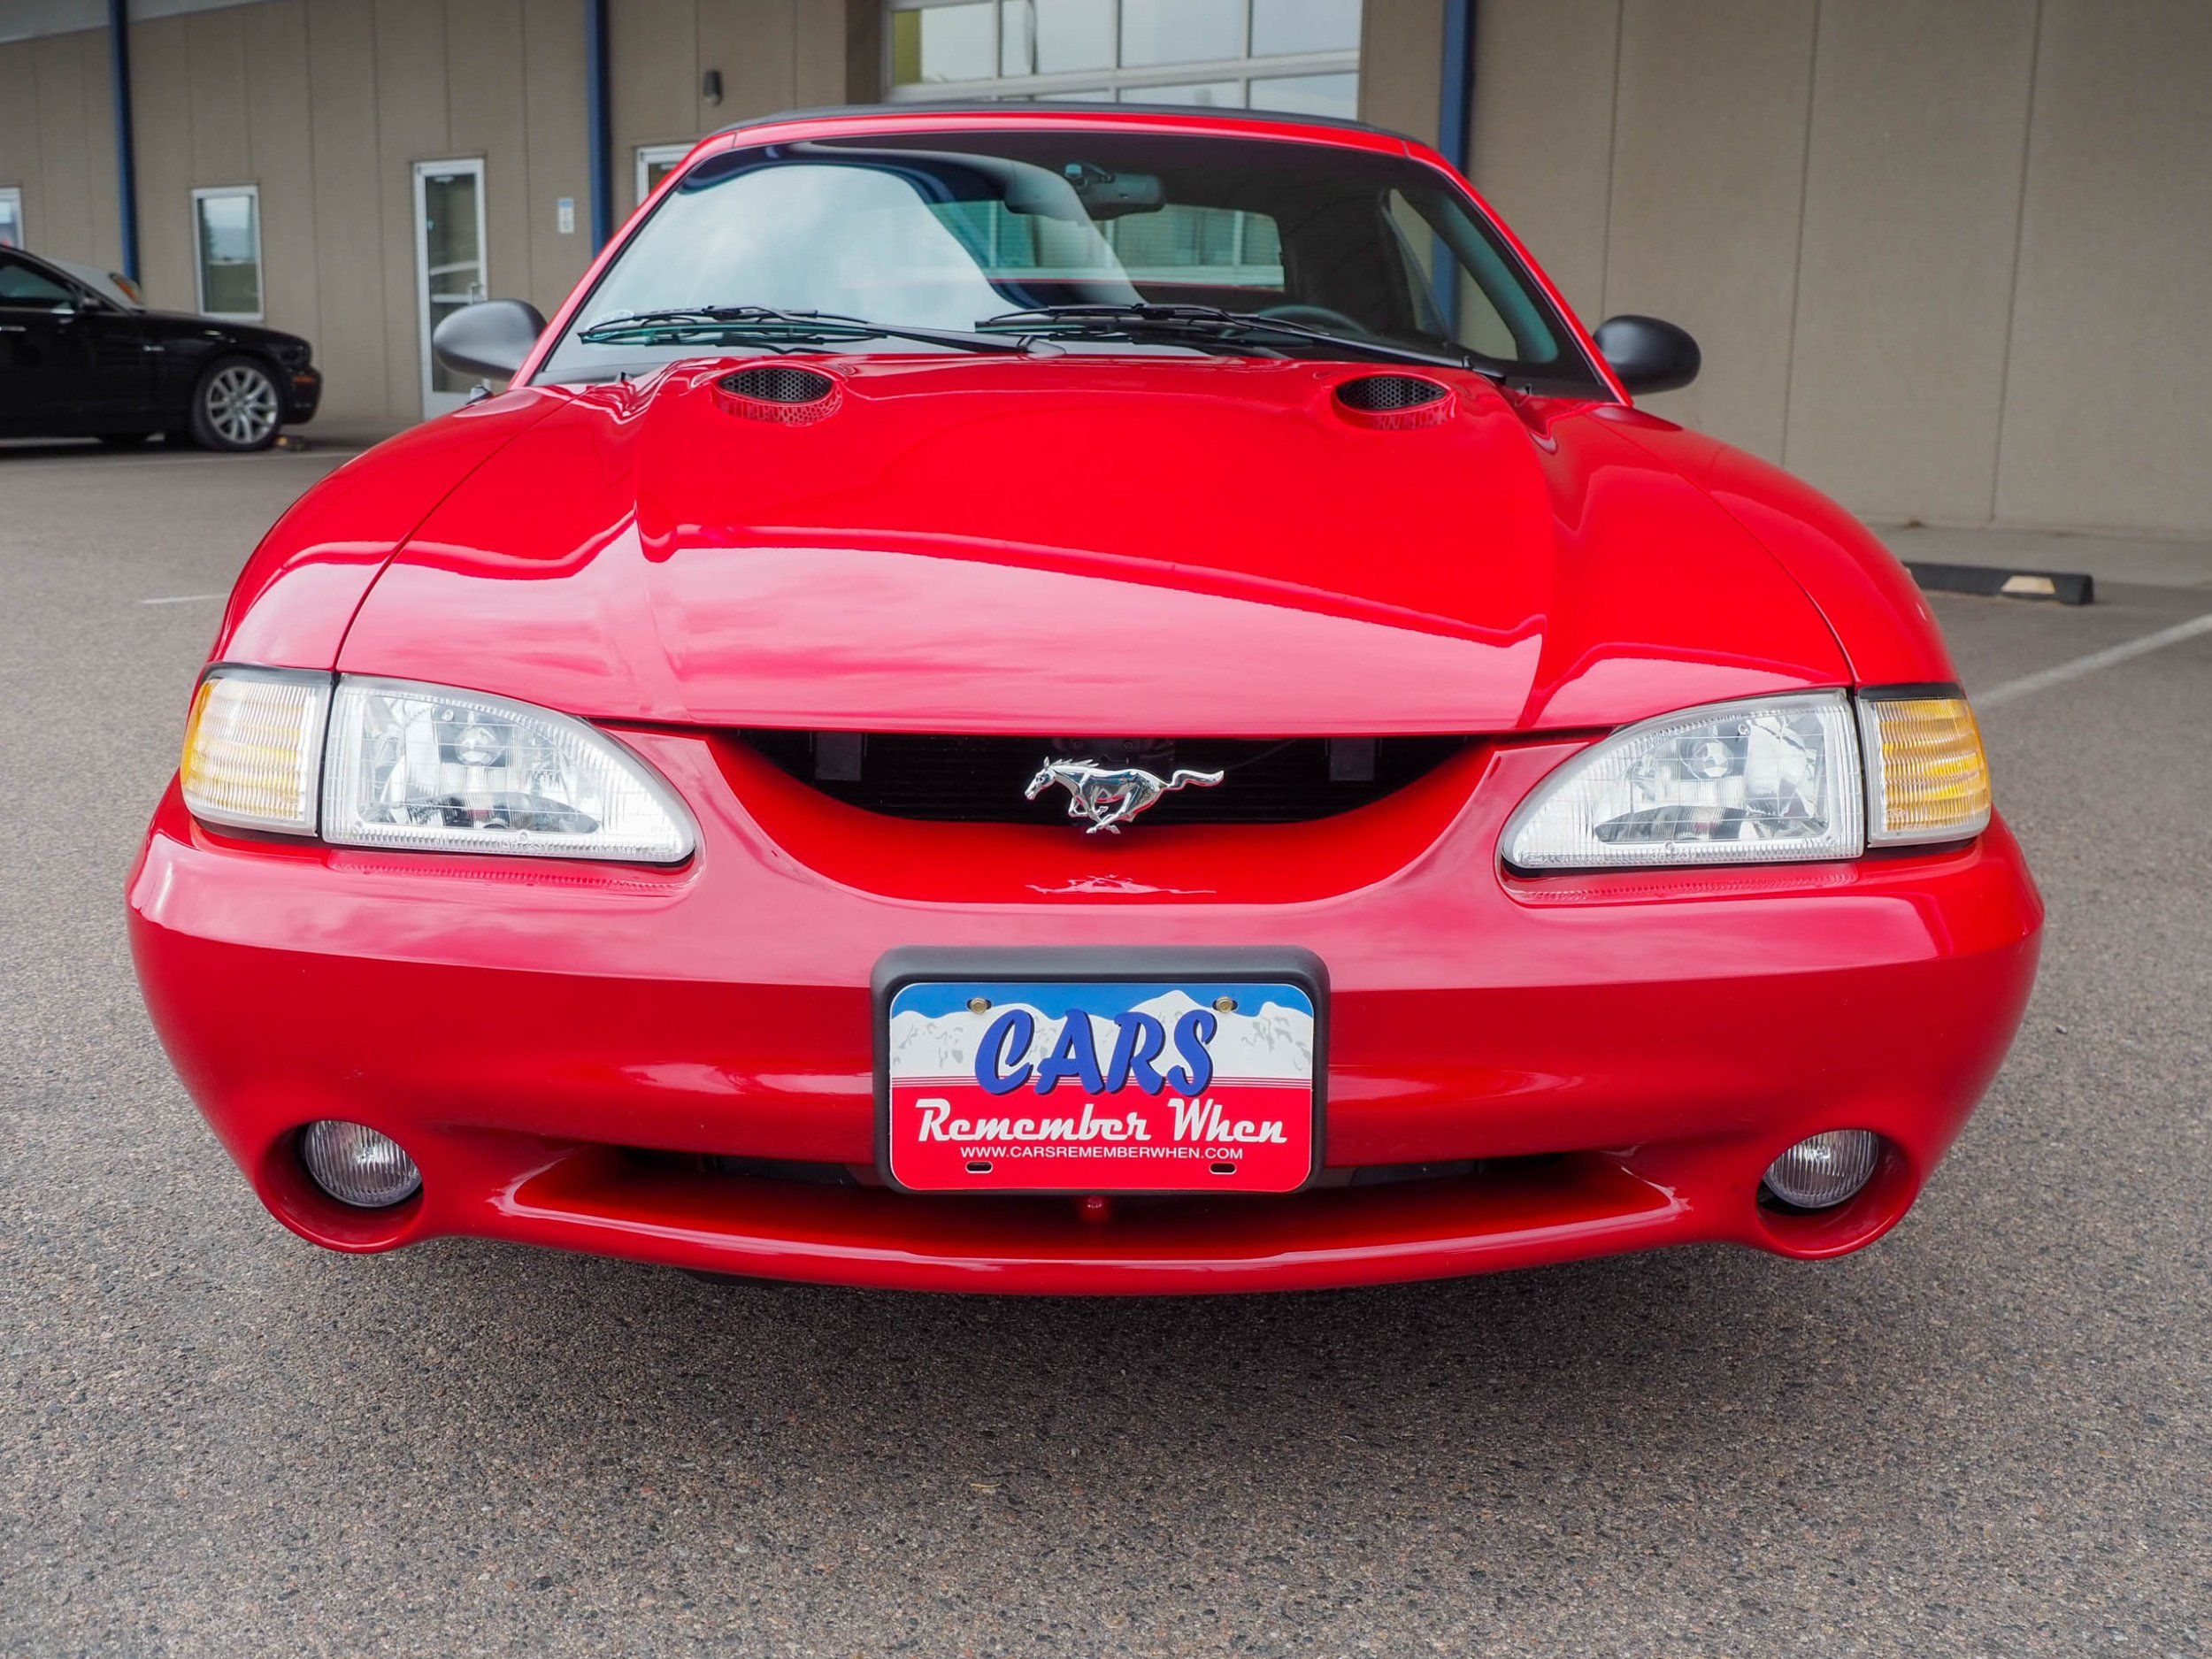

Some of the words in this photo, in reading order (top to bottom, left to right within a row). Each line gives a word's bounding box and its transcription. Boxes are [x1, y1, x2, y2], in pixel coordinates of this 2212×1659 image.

[974, 1008, 1217, 1097] CARS
[915, 1098, 1152, 1142] Remember
[1167, 1097, 1287, 1144] When
[960, 1146, 1243, 1160] WWW.CARSREMEMBERWHEN.COM
